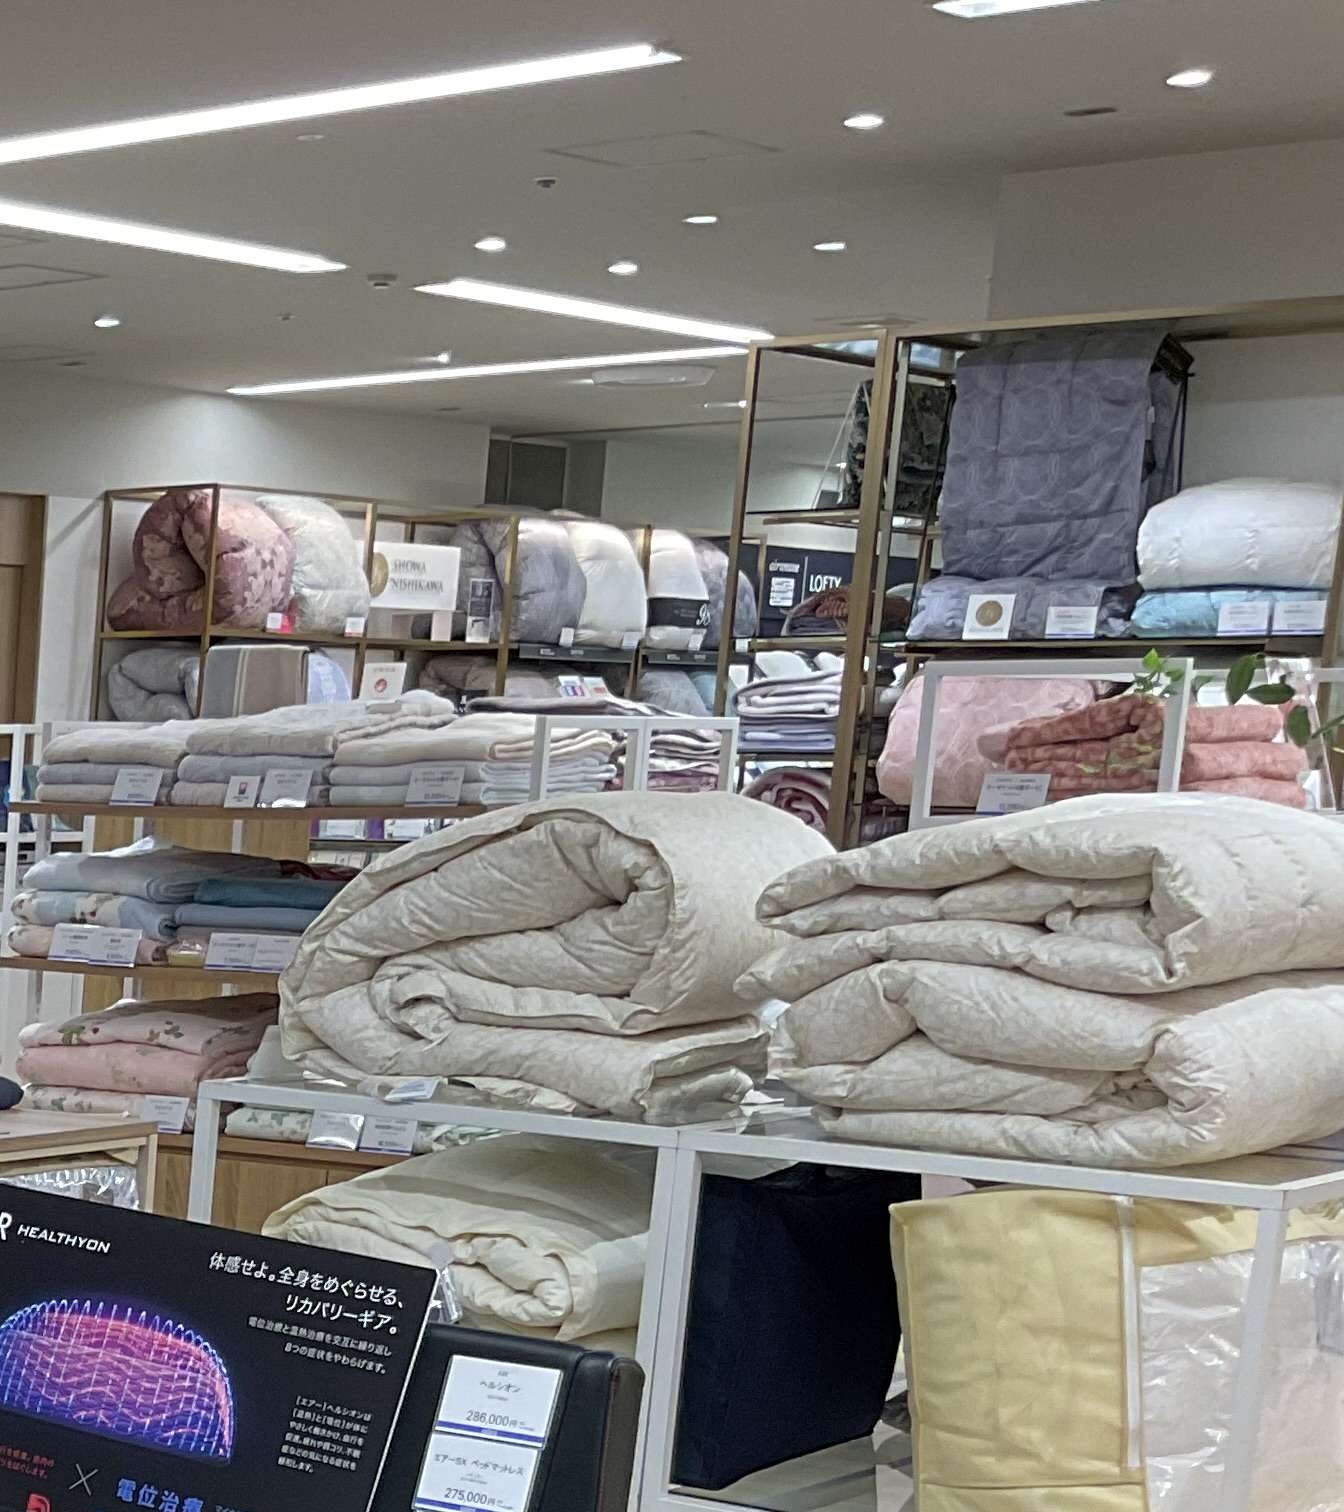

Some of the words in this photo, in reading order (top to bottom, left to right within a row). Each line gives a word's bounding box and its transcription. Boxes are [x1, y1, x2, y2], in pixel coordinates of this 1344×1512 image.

[809, 574, 842, 593] LOFTY
[16, 1224, 111, 1254] HEALTHYON
[285, 1294, 399, 1335] リカバリーギア。
